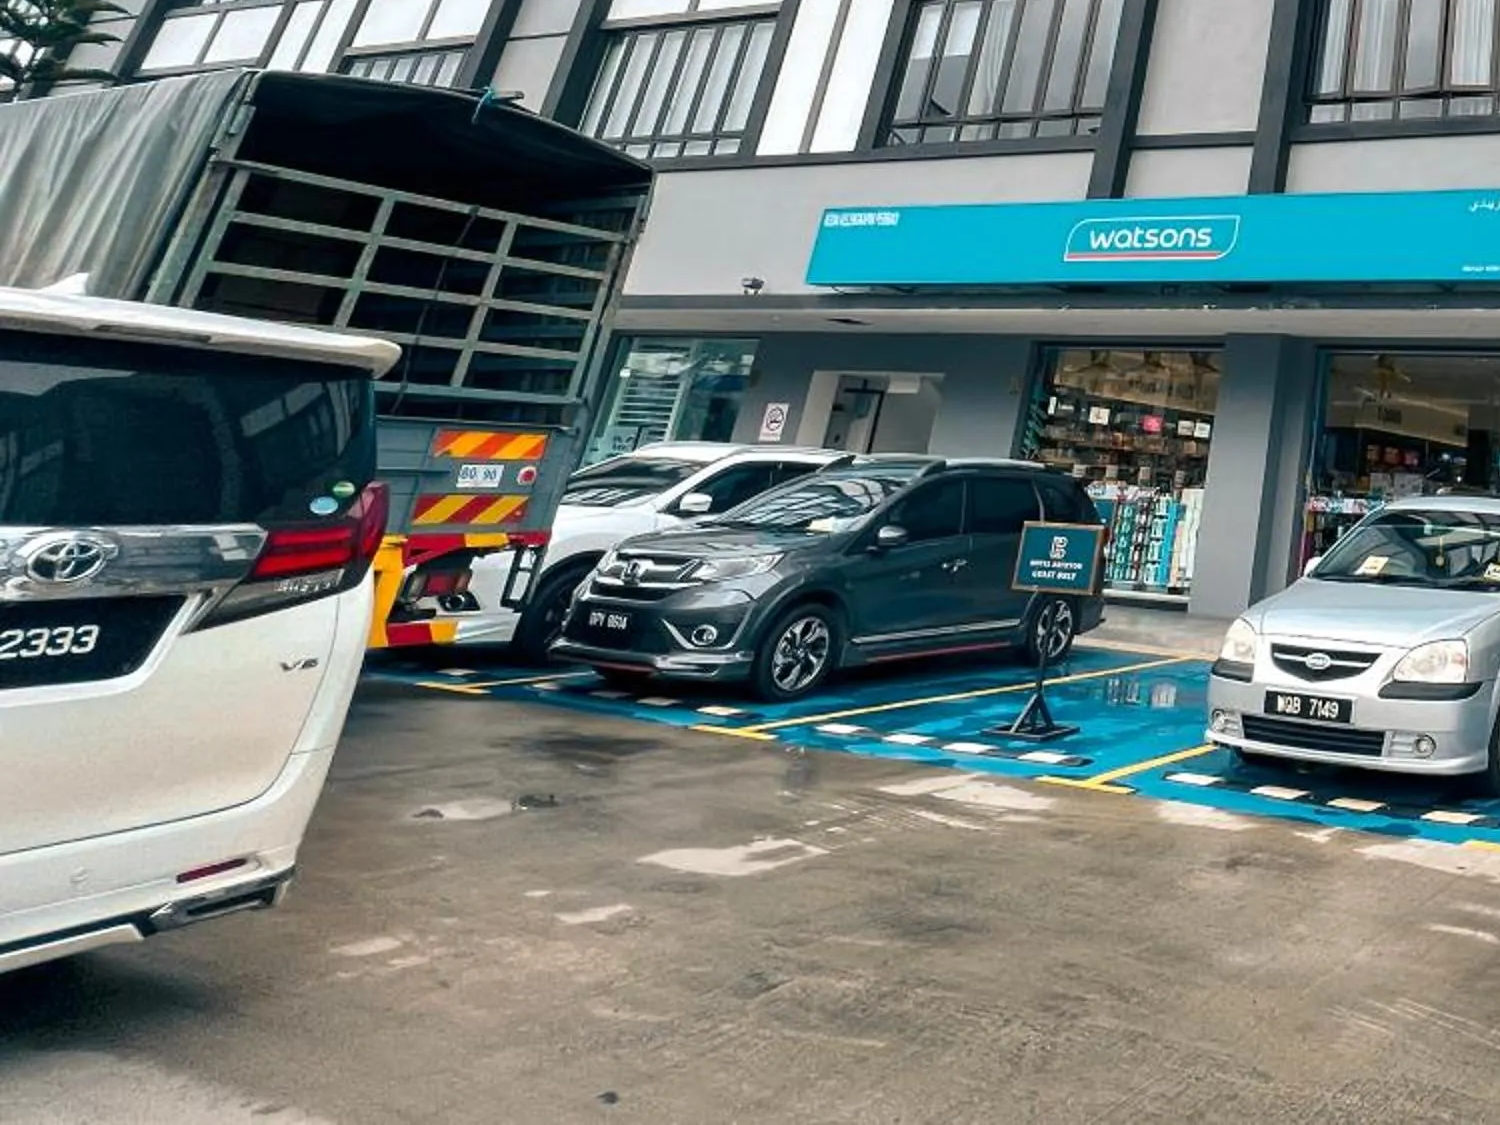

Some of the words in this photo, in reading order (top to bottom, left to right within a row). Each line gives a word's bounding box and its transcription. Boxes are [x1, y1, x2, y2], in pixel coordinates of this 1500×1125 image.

[1089, 226, 1212, 250] watsons
[0, 624, 101, 660] 2333
[1309, 698, 1339, 719] 7149
